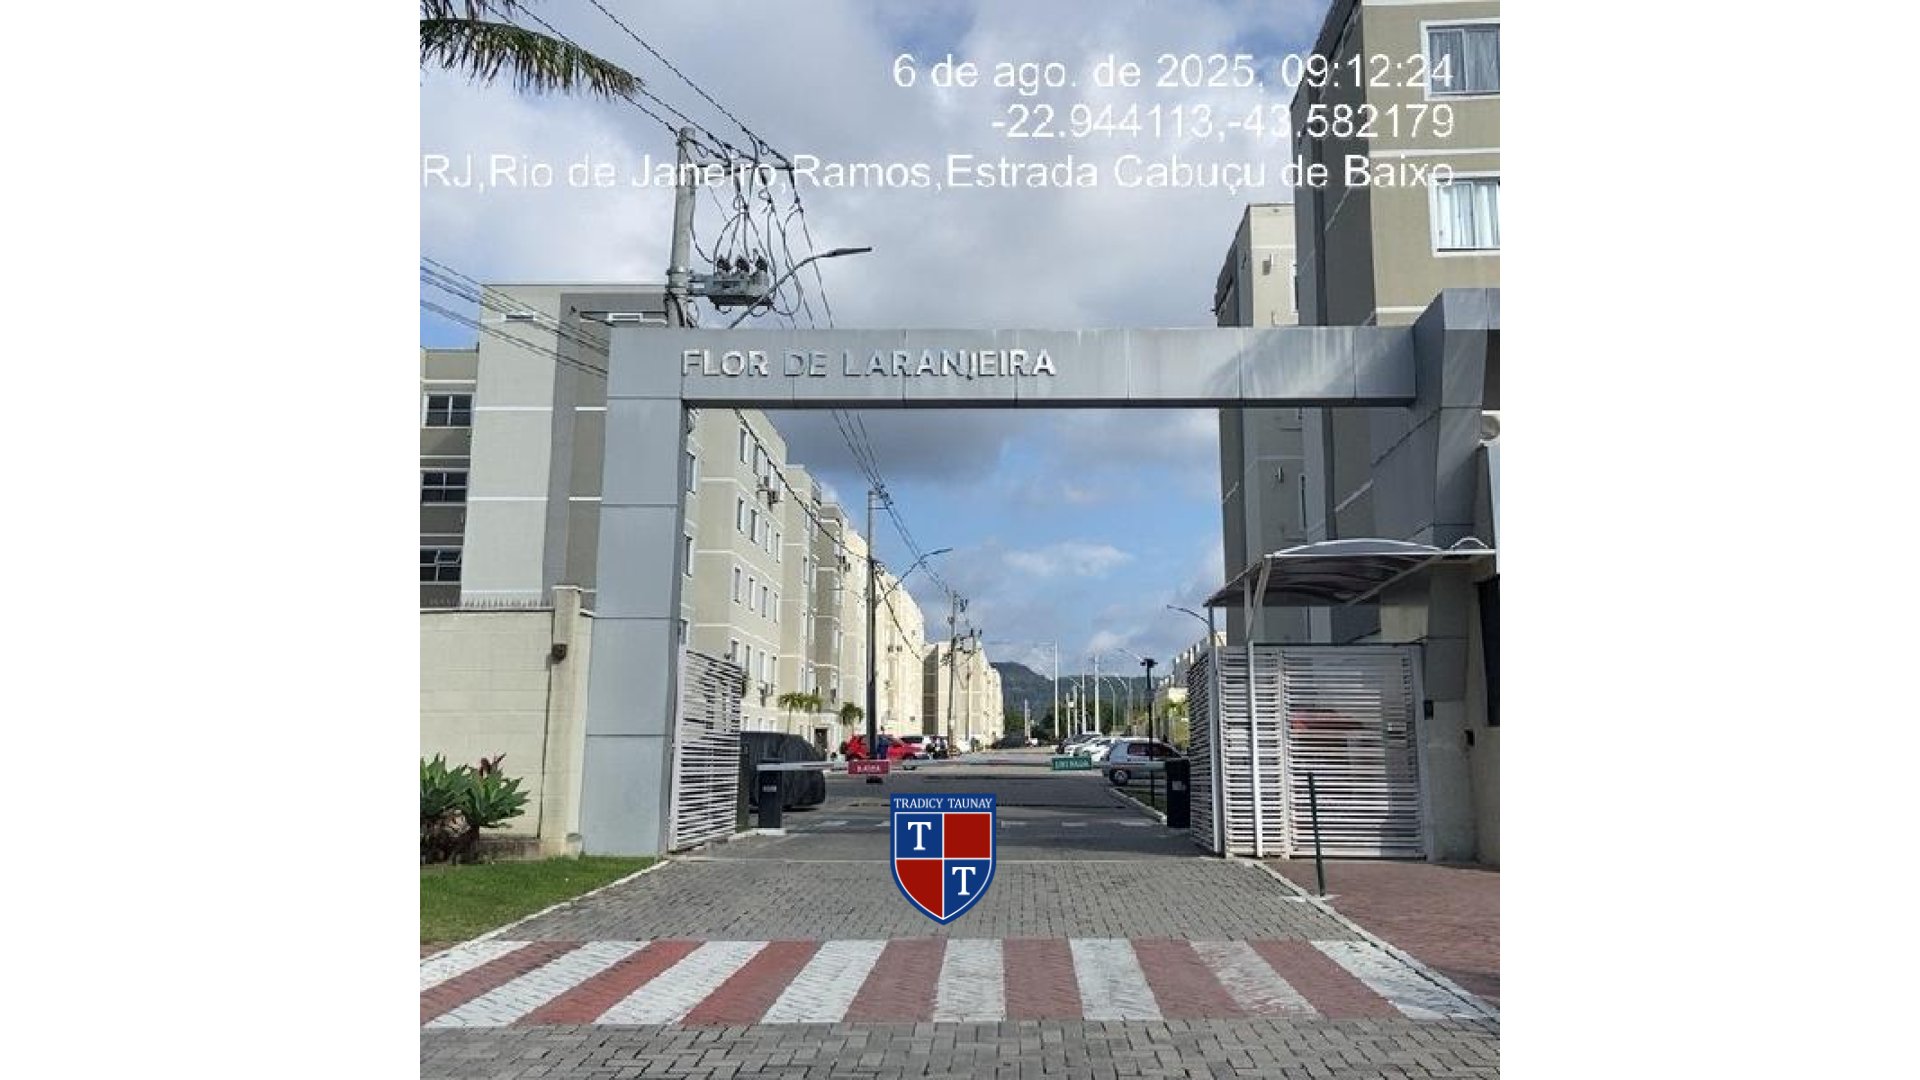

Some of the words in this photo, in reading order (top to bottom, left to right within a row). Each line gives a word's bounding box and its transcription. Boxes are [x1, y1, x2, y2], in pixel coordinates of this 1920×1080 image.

[681, 350, 769, 377] FLOR
[783, 350, 827, 377] DE
[842, 349, 1056, 381] LARANJEIRA
